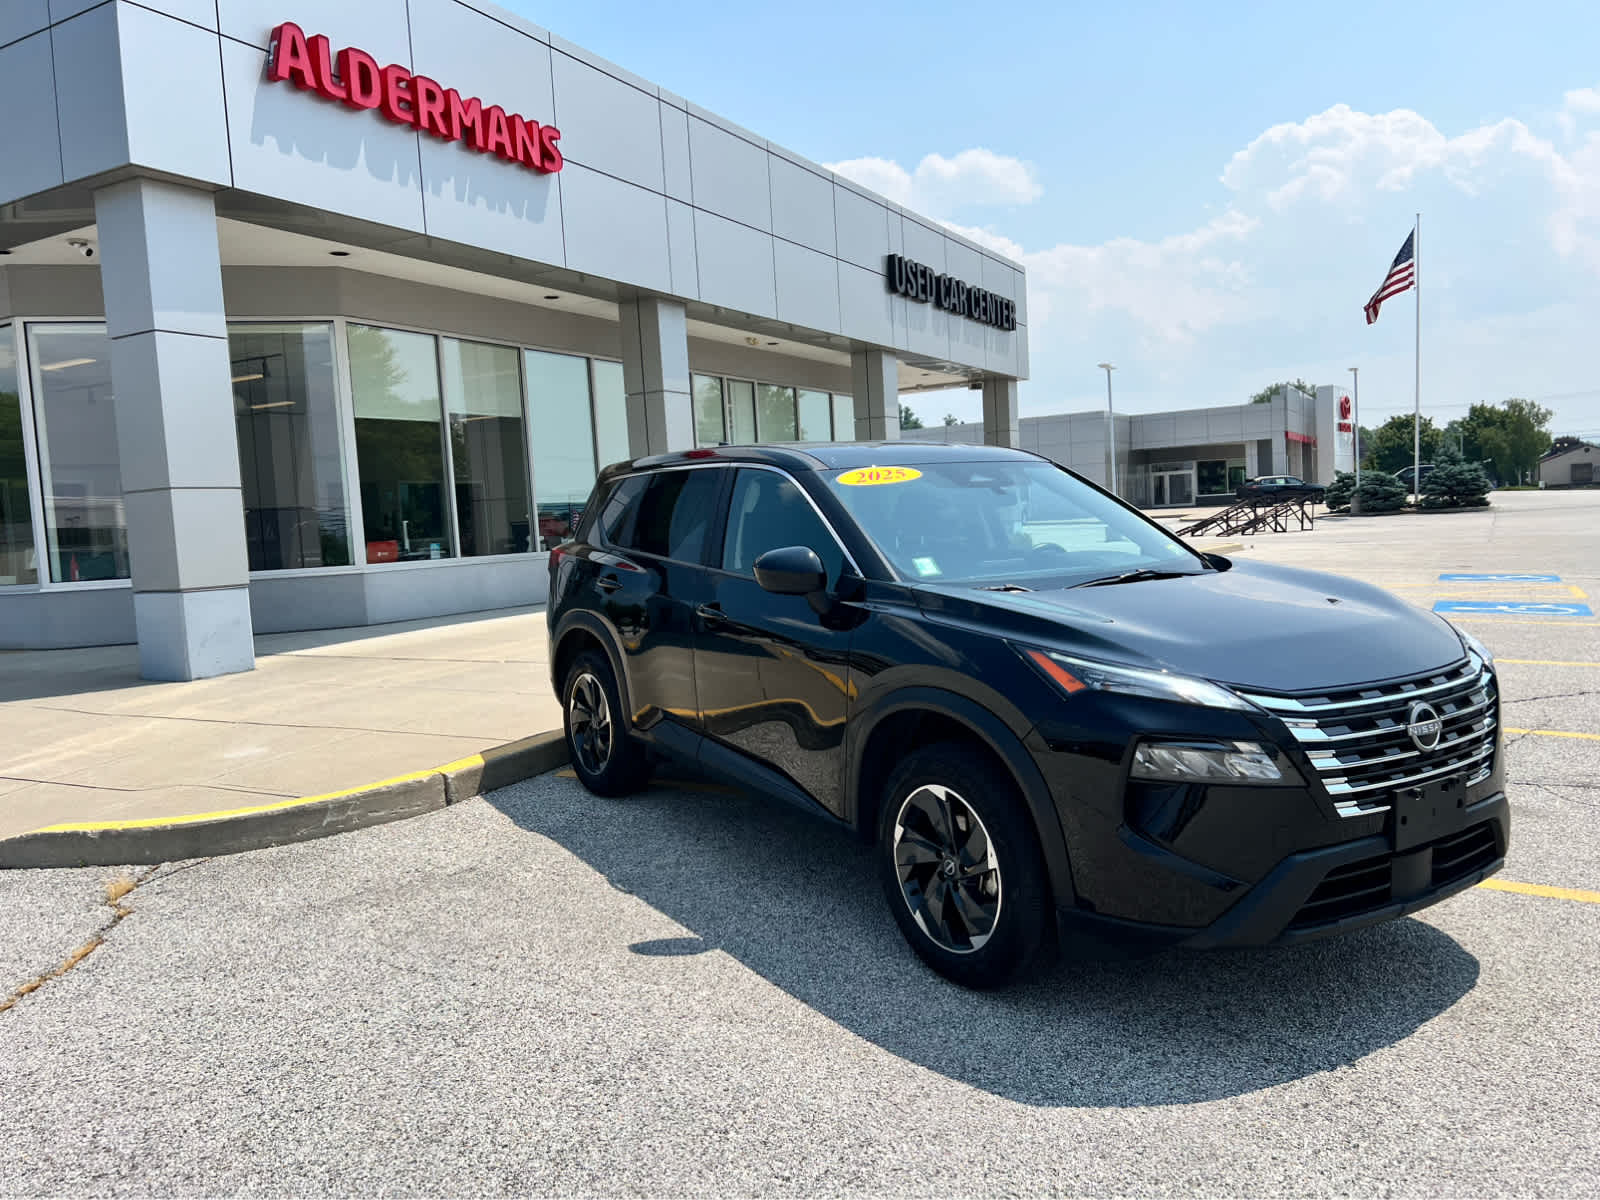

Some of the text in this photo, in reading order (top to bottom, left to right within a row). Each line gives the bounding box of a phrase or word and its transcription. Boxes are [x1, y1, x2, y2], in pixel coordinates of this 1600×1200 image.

[269, 22, 563, 174] ALDERMANS
[888, 254, 1016, 331] USED CAR CENTER
[856, 468, 906, 483] 2025
[1408, 722, 1441, 735] NISSA
